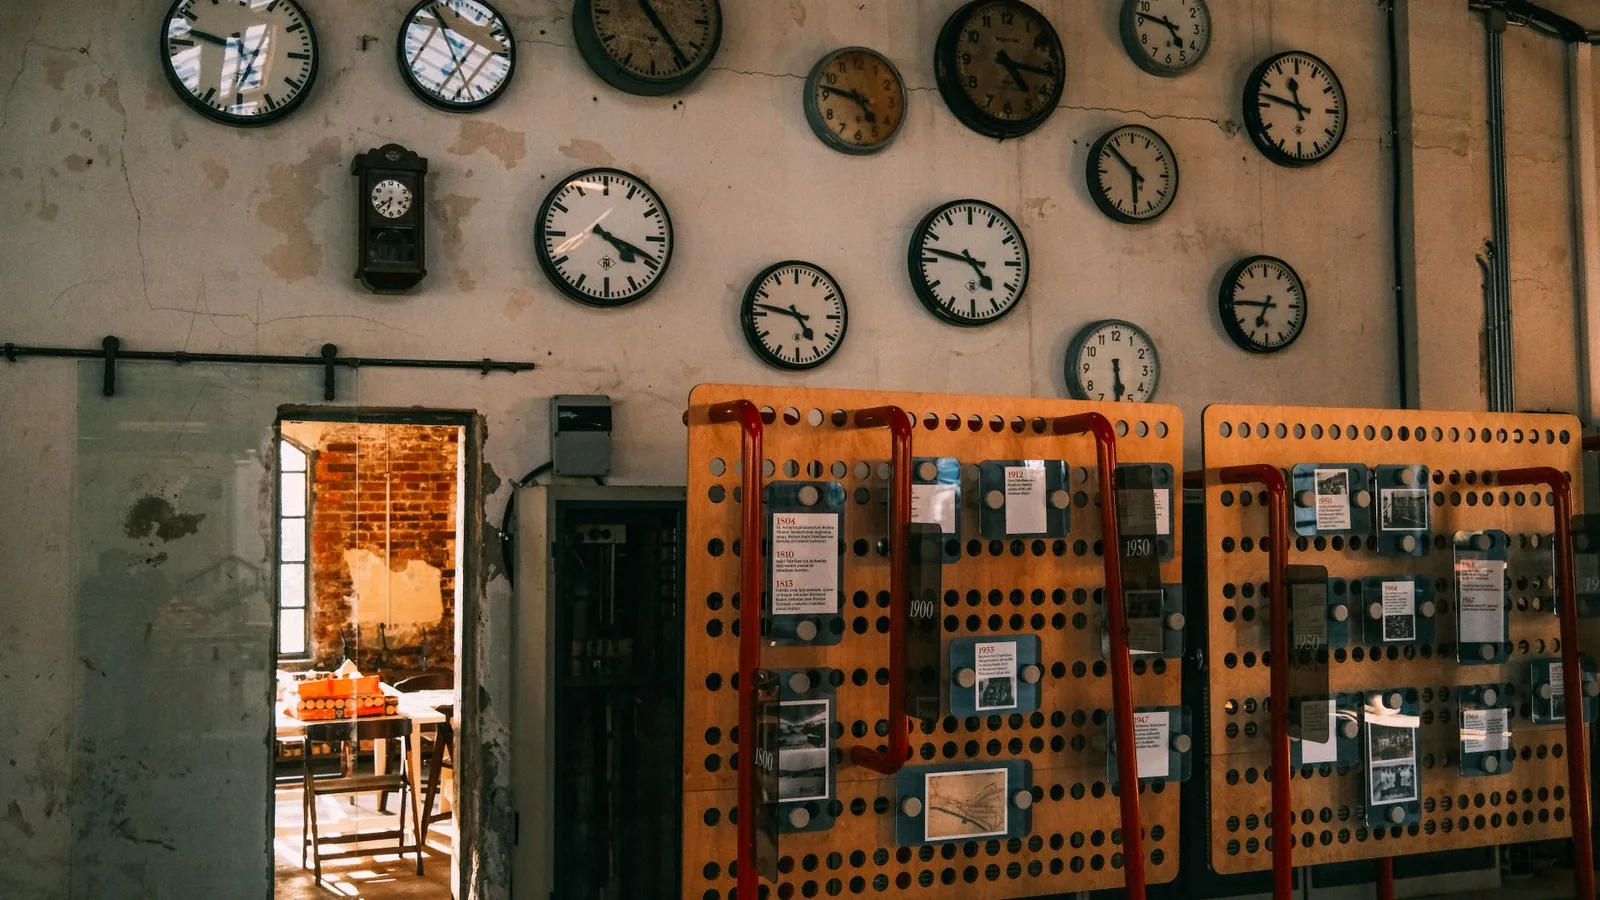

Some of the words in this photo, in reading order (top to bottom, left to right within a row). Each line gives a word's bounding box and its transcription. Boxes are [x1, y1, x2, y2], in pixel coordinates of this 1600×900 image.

[1141, 1, 1150, 12] 10
[1001, 12, 1014, 25] 12
[1190, 8, 1196, 18] 2
[982, 16, 991, 28] 11
[1138, 17, 1144, 27] 9
[1194, 24, 1200, 34] 3
[968, 30, 980, 44] 10
[1142, 34, 1148, 44] 8
[1190, 40, 1196, 50] 4
[1152, 47, 1158, 56] 7
[1180, 51, 1186, 60] 5
[854, 58, 864, 70] 12
[962, 54, 970, 64] 9
[1166, 54, 1172, 64] 6
[838, 62, 846, 73] 11
[826, 73, 836, 84] 10
[968, 76, 978, 88] 8
[884, 80, 890, 91] 2
[822, 90, 830, 101] 9
[985, 94, 994, 108] 7
[888, 97, 894, 108] 3
[1024, 98, 1032, 112] 5
[826, 108, 834, 120] 8
[1003, 102, 1012, 115] 6
[838, 123, 846, 134] 7
[872, 126, 878, 138] 5
[855, 130, 862, 140] 6
[1098, 334, 1104, 345] 11
[1111, 330, 1120, 341] 12
[1129, 336, 1132, 346] 1
[1086, 346, 1096, 357] 10
[1138, 348, 1144, 360] 2
[1083, 363, 1090, 374] 9
[1142, 366, 1148, 376] 3
[1087, 380, 1094, 391] 8
[1137, 382, 1144, 392] 4
[1098, 393, 1104, 401] 7
[1128, 394, 1133, 402] 5
[776, 517, 796, 525] 1804
[1126, 538, 1150, 556] 1930
[776, 551, 794, 559] 1810
[776, 580, 794, 588] 1813
[910, 600, 934, 618] 1900
[754, 748, 773, 771] 1800
